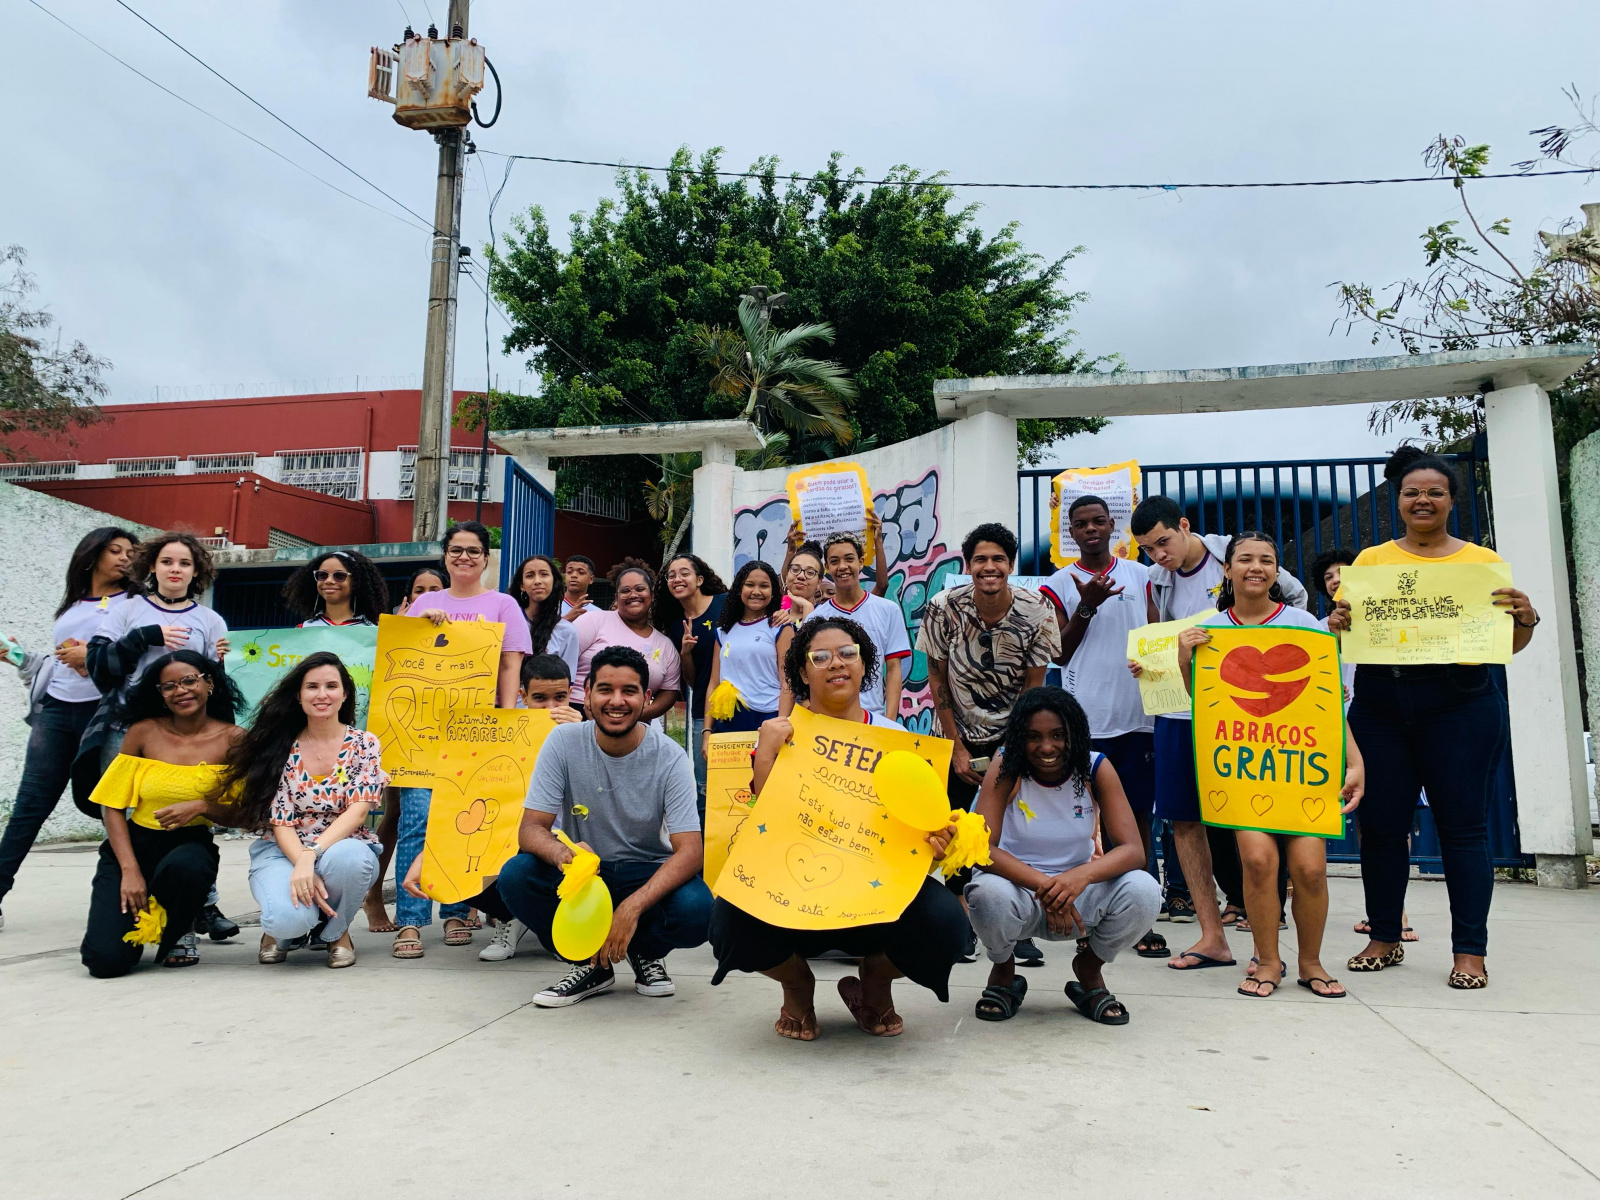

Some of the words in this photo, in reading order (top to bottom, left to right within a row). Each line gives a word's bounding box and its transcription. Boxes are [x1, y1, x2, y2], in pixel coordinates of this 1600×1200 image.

[1362, 596, 1376, 606] NÃO
[1380, 597, 1408, 606] PERMITA
[1410, 598, 1428, 606] QUE
[1434, 596, 1454, 605] UNS
[1416, 603, 1464, 614] DETERMINEM
[1364, 613, 1374, 621] O
[1402, 612, 1411, 620] DA
[446, 726, 514, 742] AMARELO
[1214, 719, 1318, 748] ABRAÇOS
[712, 742, 756, 750] CONSCIENTIZE
[1213, 744, 1330, 787] GRÁTIS
[798, 782, 824, 813] Está
[830, 809, 851, 830] tudo
[798, 812, 814, 828] não
[816, 825, 845, 846] estar
[733, 864, 756, 889] Você
[766, 890, 790, 908] não
[798, 902, 830, 918] está
